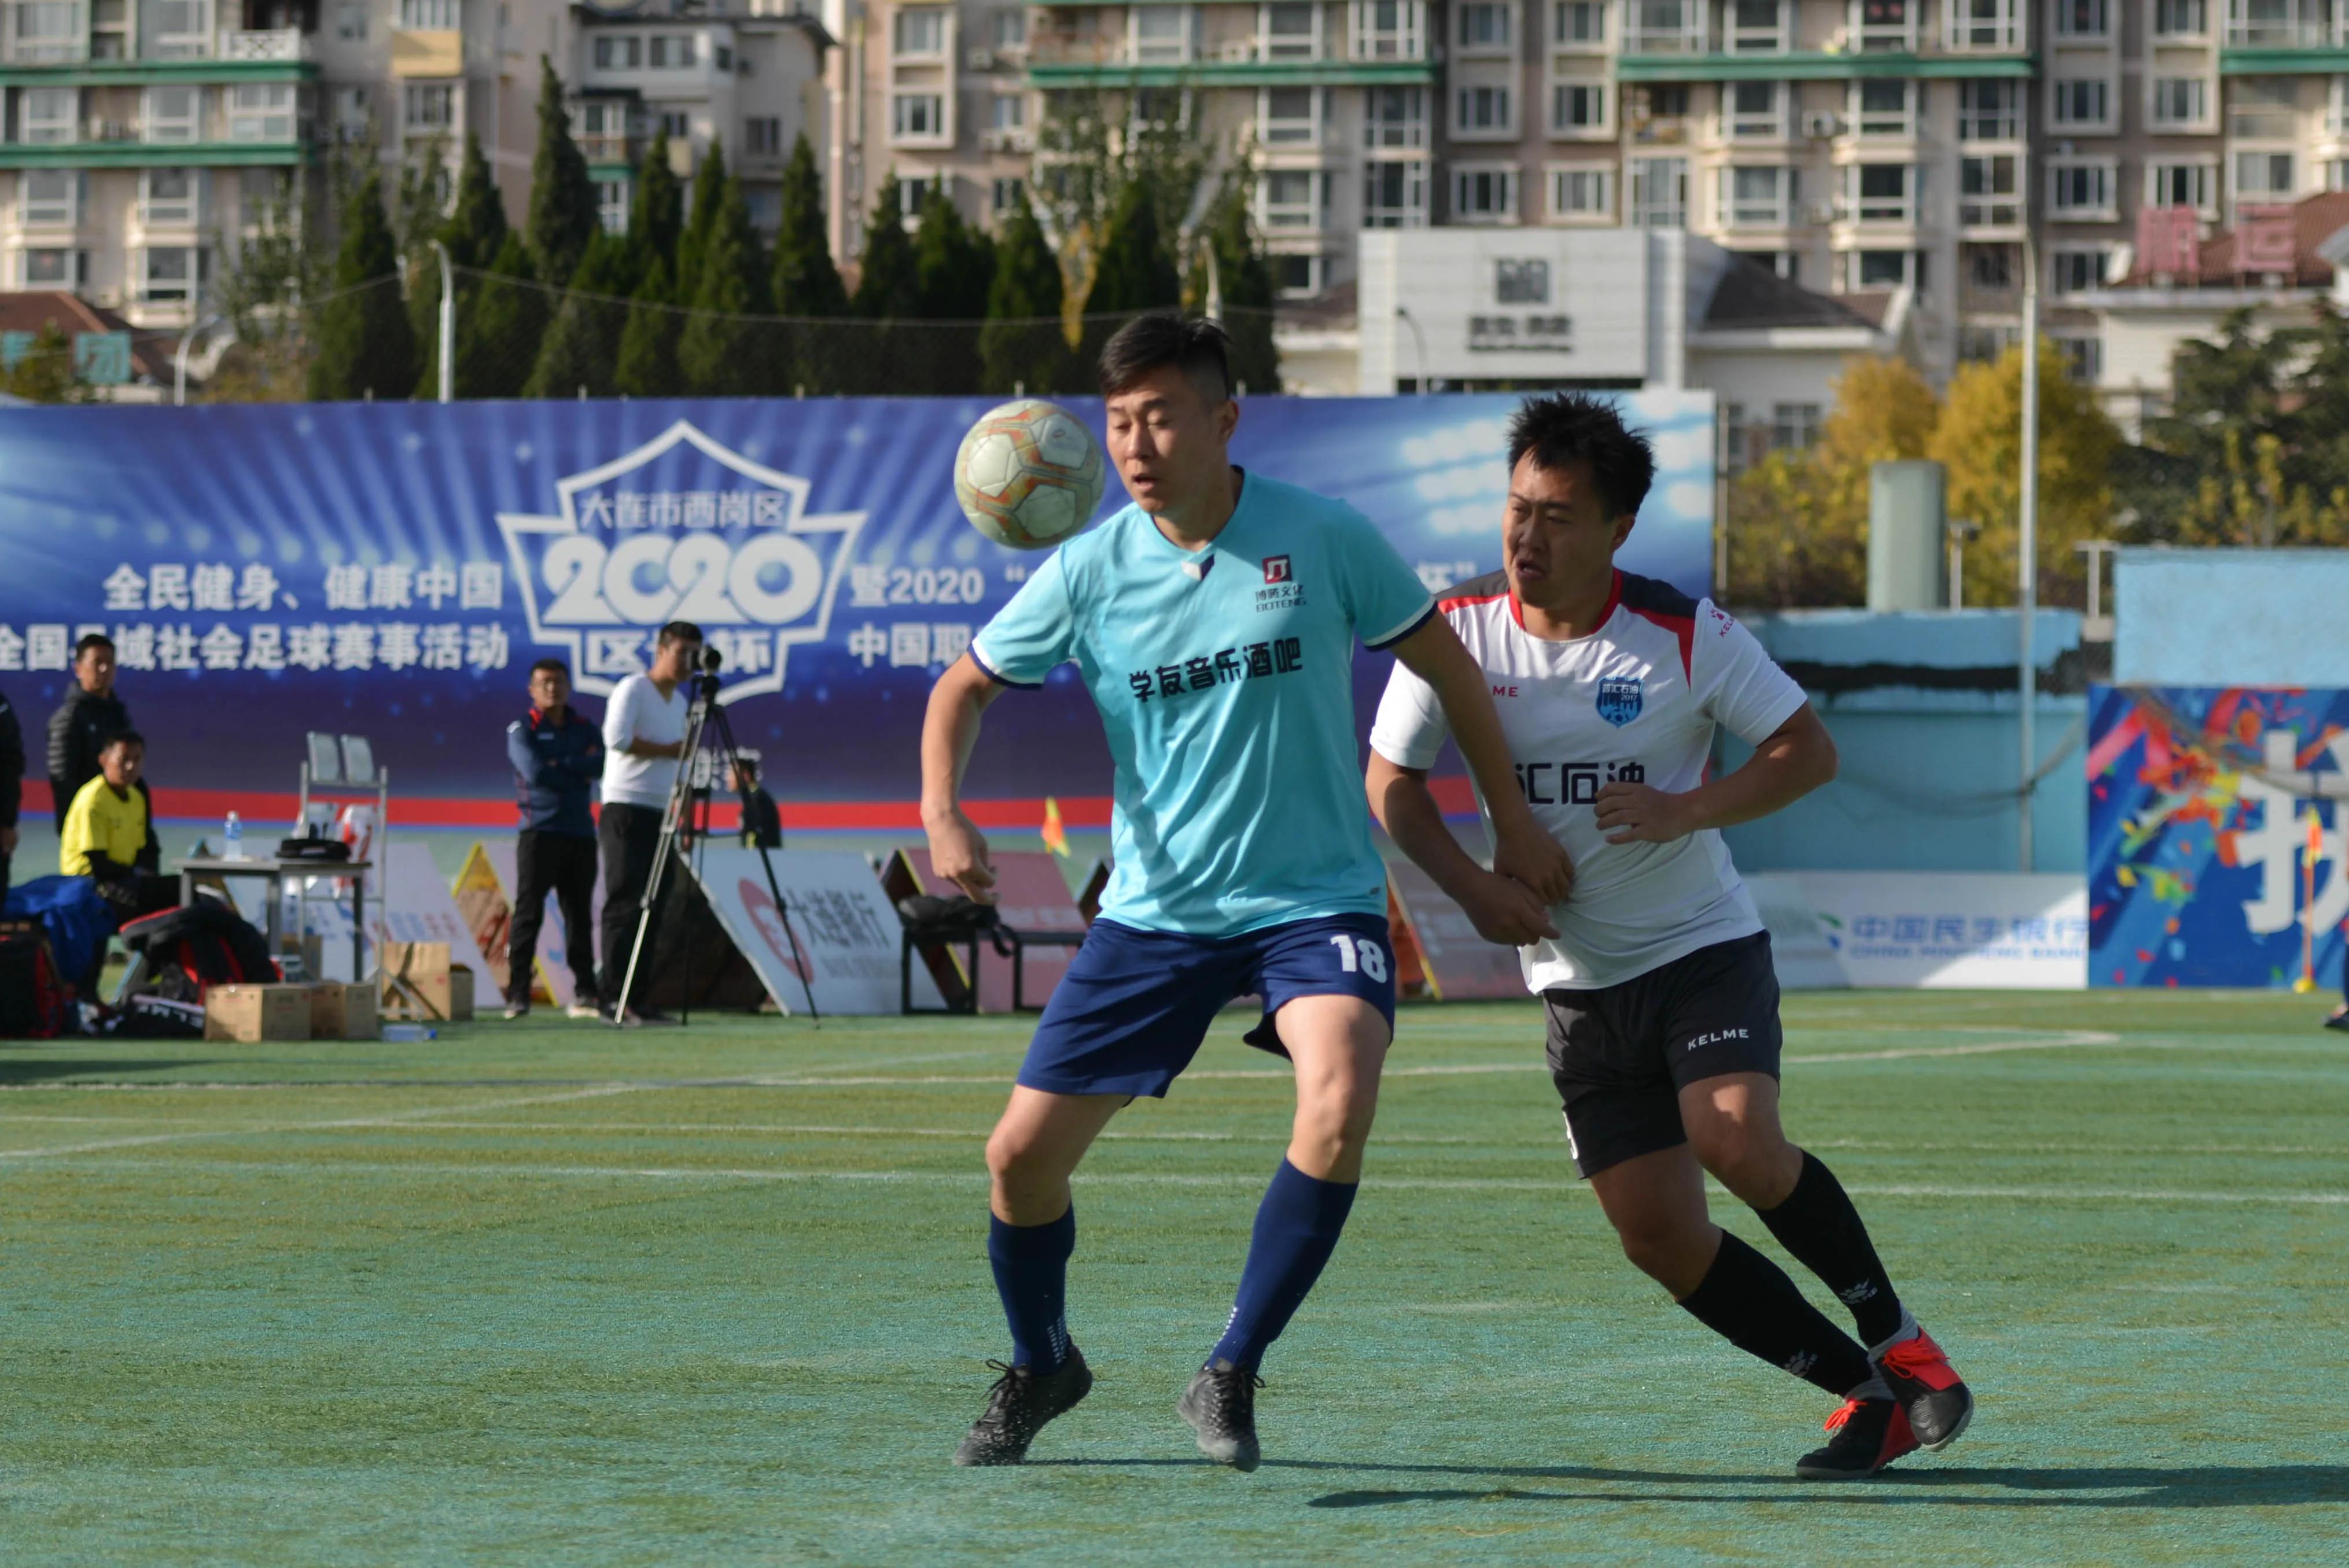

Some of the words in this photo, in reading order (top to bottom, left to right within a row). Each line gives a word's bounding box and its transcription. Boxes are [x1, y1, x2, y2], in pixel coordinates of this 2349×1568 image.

[580, 491, 785, 530] 大连市西岗区
[541, 532, 824, 625] 2020
[0, 623, 509, 671] 全国域社会足球赛事活动
[586, 628, 771, 675] 区杯
[848, 621, 984, 668] 中国职
[1129, 637, 1303, 703] 学友音乐酒吧
[1330, 934, 1387, 983] 18
[1688, 1028, 1748, 1051] KELME
